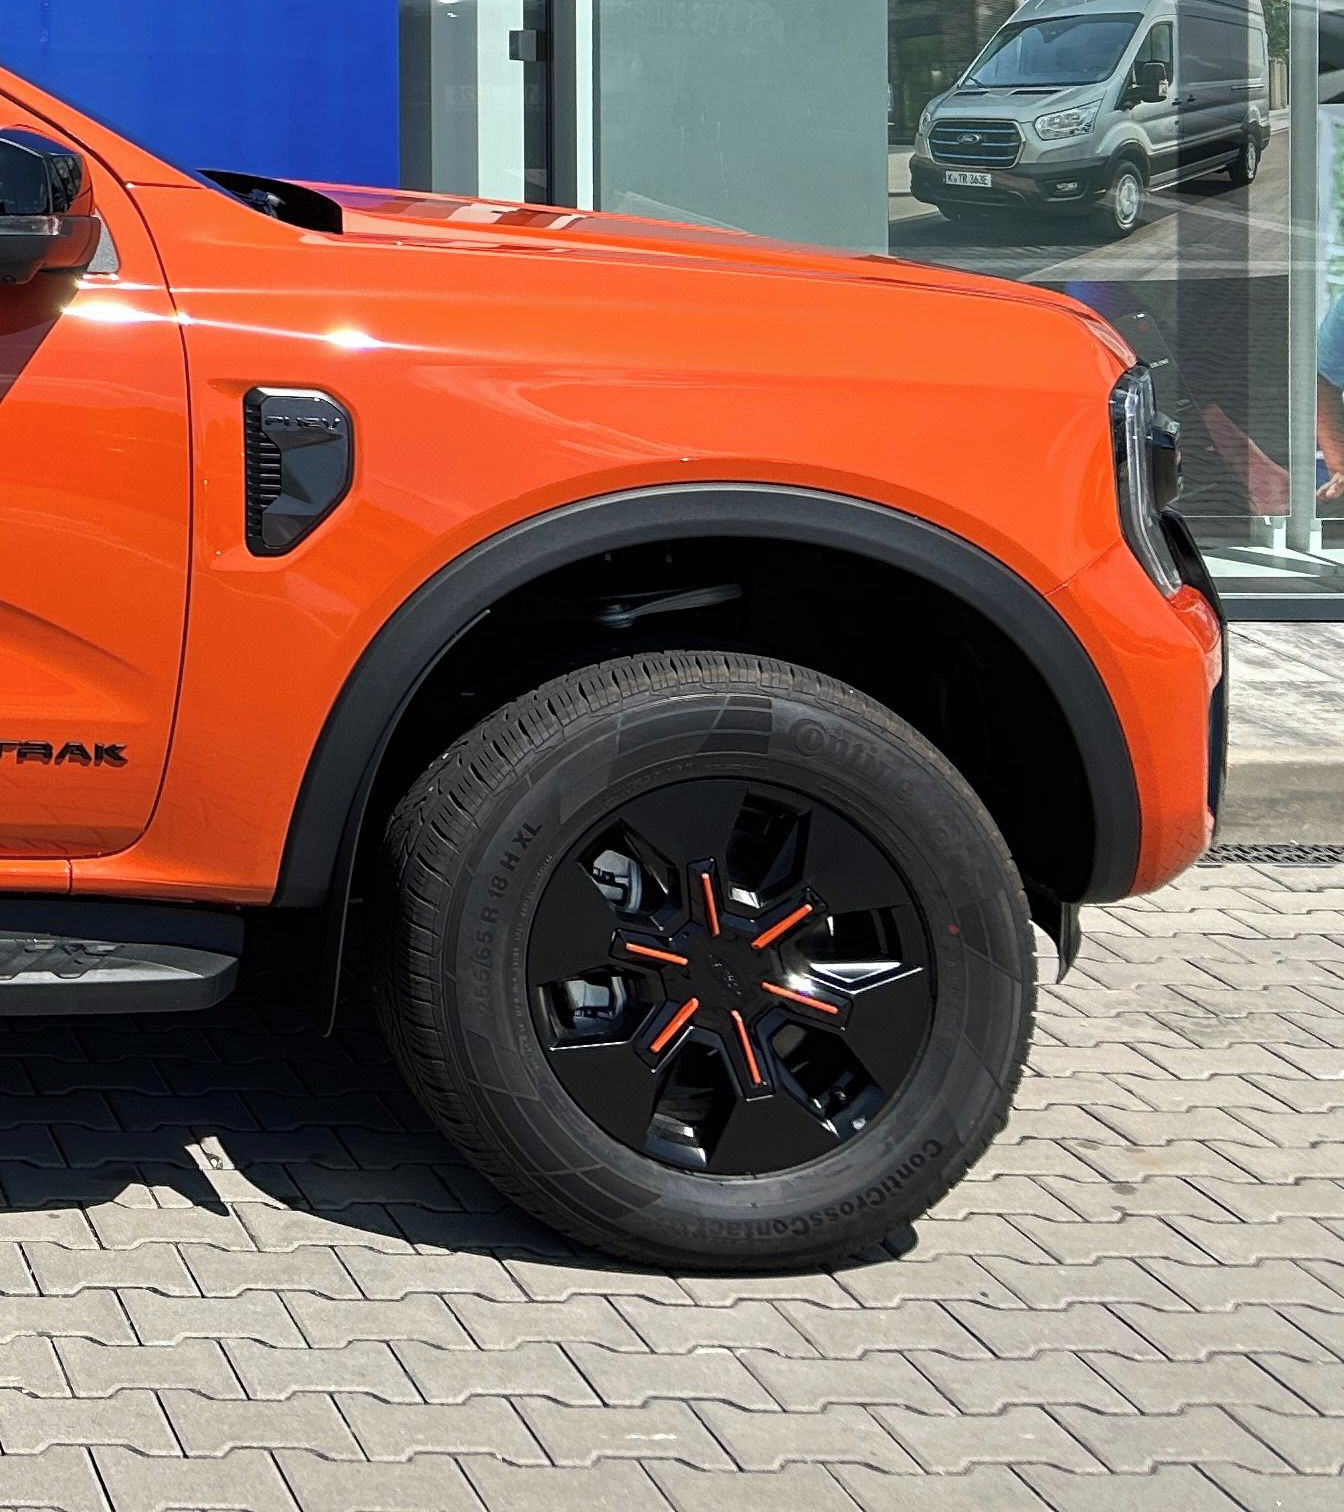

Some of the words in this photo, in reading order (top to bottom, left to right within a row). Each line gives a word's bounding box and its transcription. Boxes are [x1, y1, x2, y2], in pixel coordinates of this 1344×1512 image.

[512, 821, 543, 850] XL
[499, 850, 521, 872] H
[488, 875, 509, 900] 18
[480, 905, 499, 924] R
